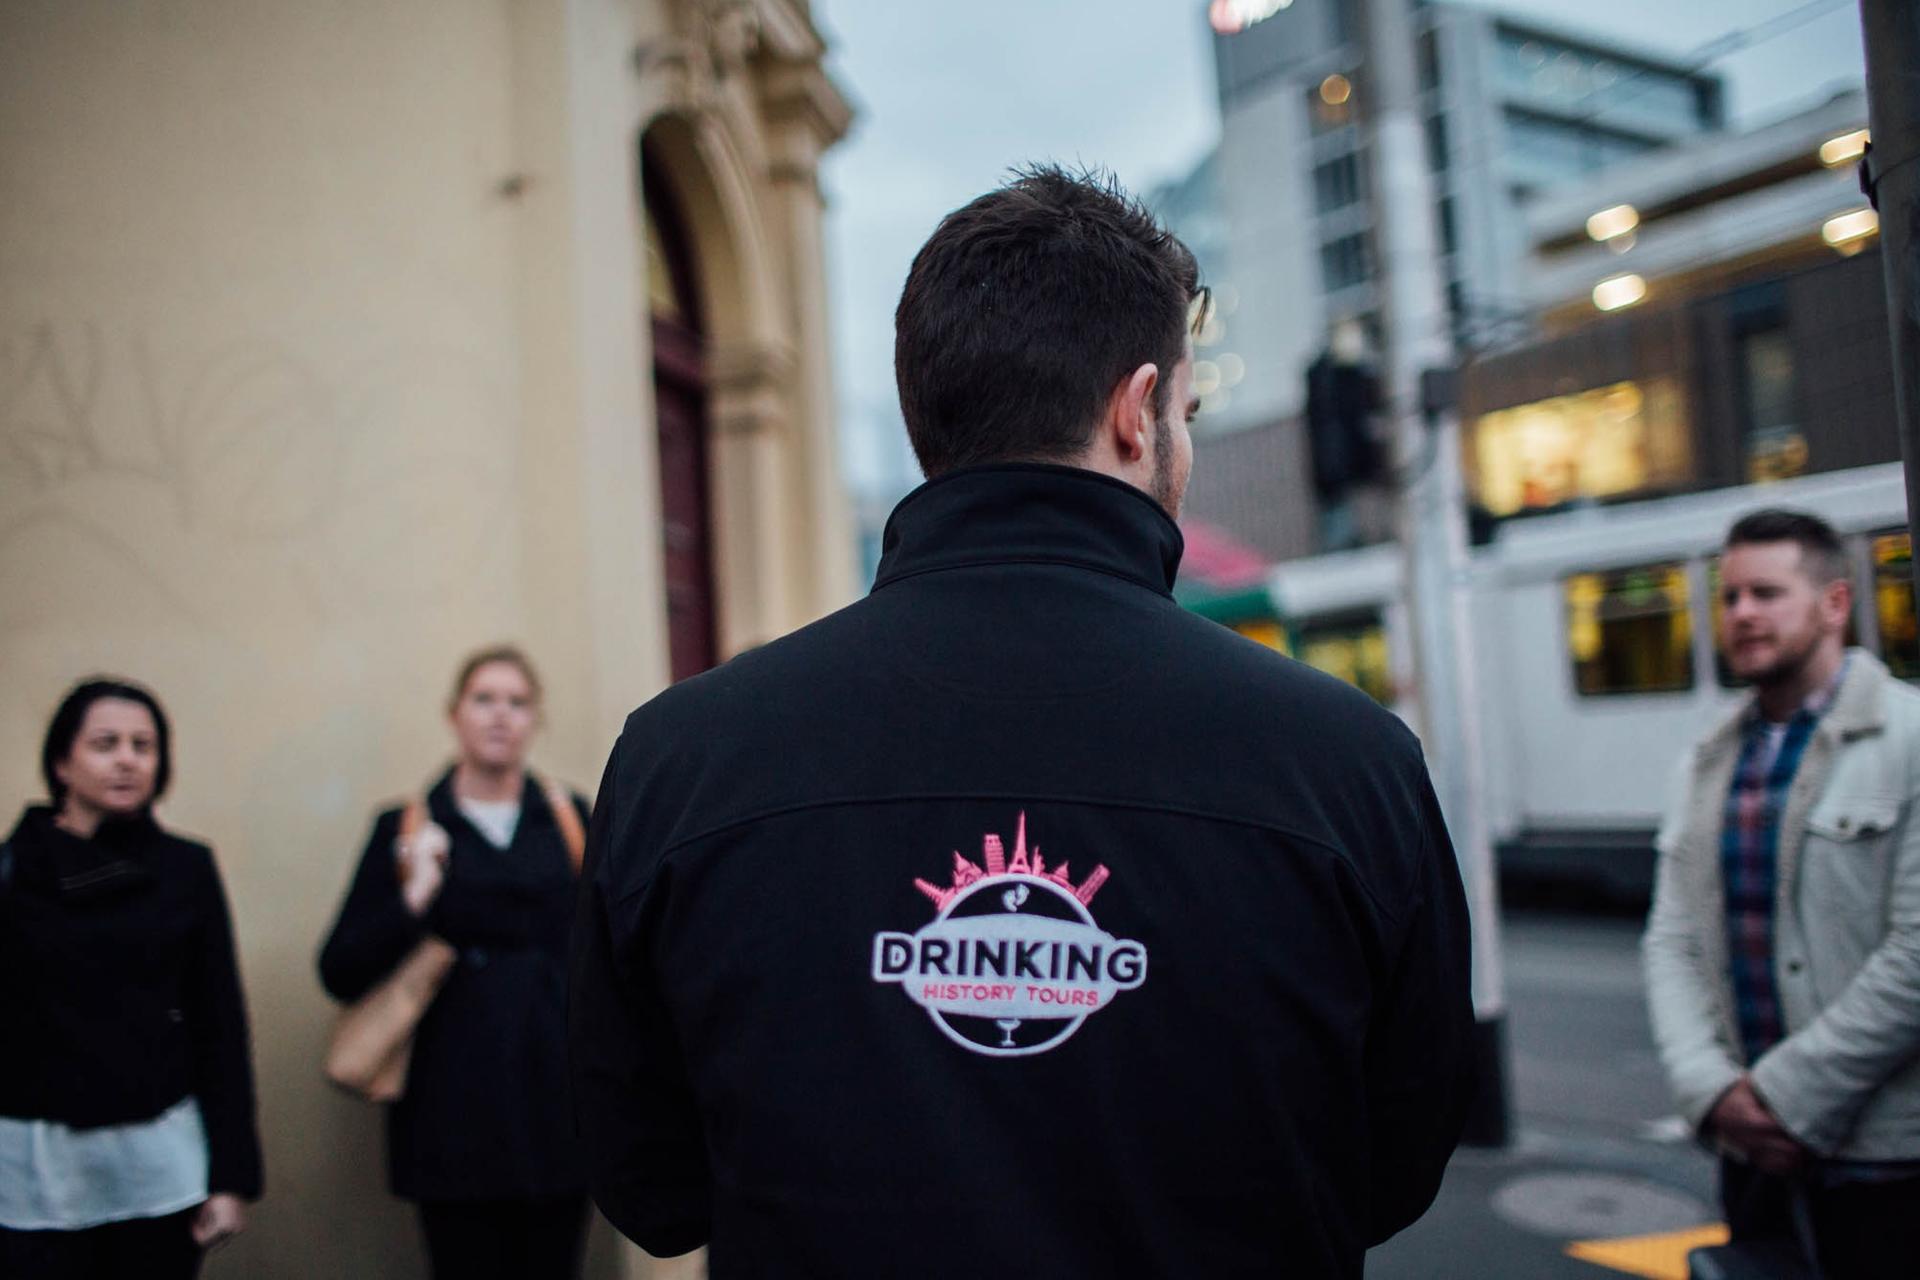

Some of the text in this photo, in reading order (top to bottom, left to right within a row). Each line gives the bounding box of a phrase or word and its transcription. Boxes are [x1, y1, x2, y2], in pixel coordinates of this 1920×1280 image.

[880, 938, 1143, 983] DRINKING
[922, 983, 1099, 1006] HISTORY TOURS
